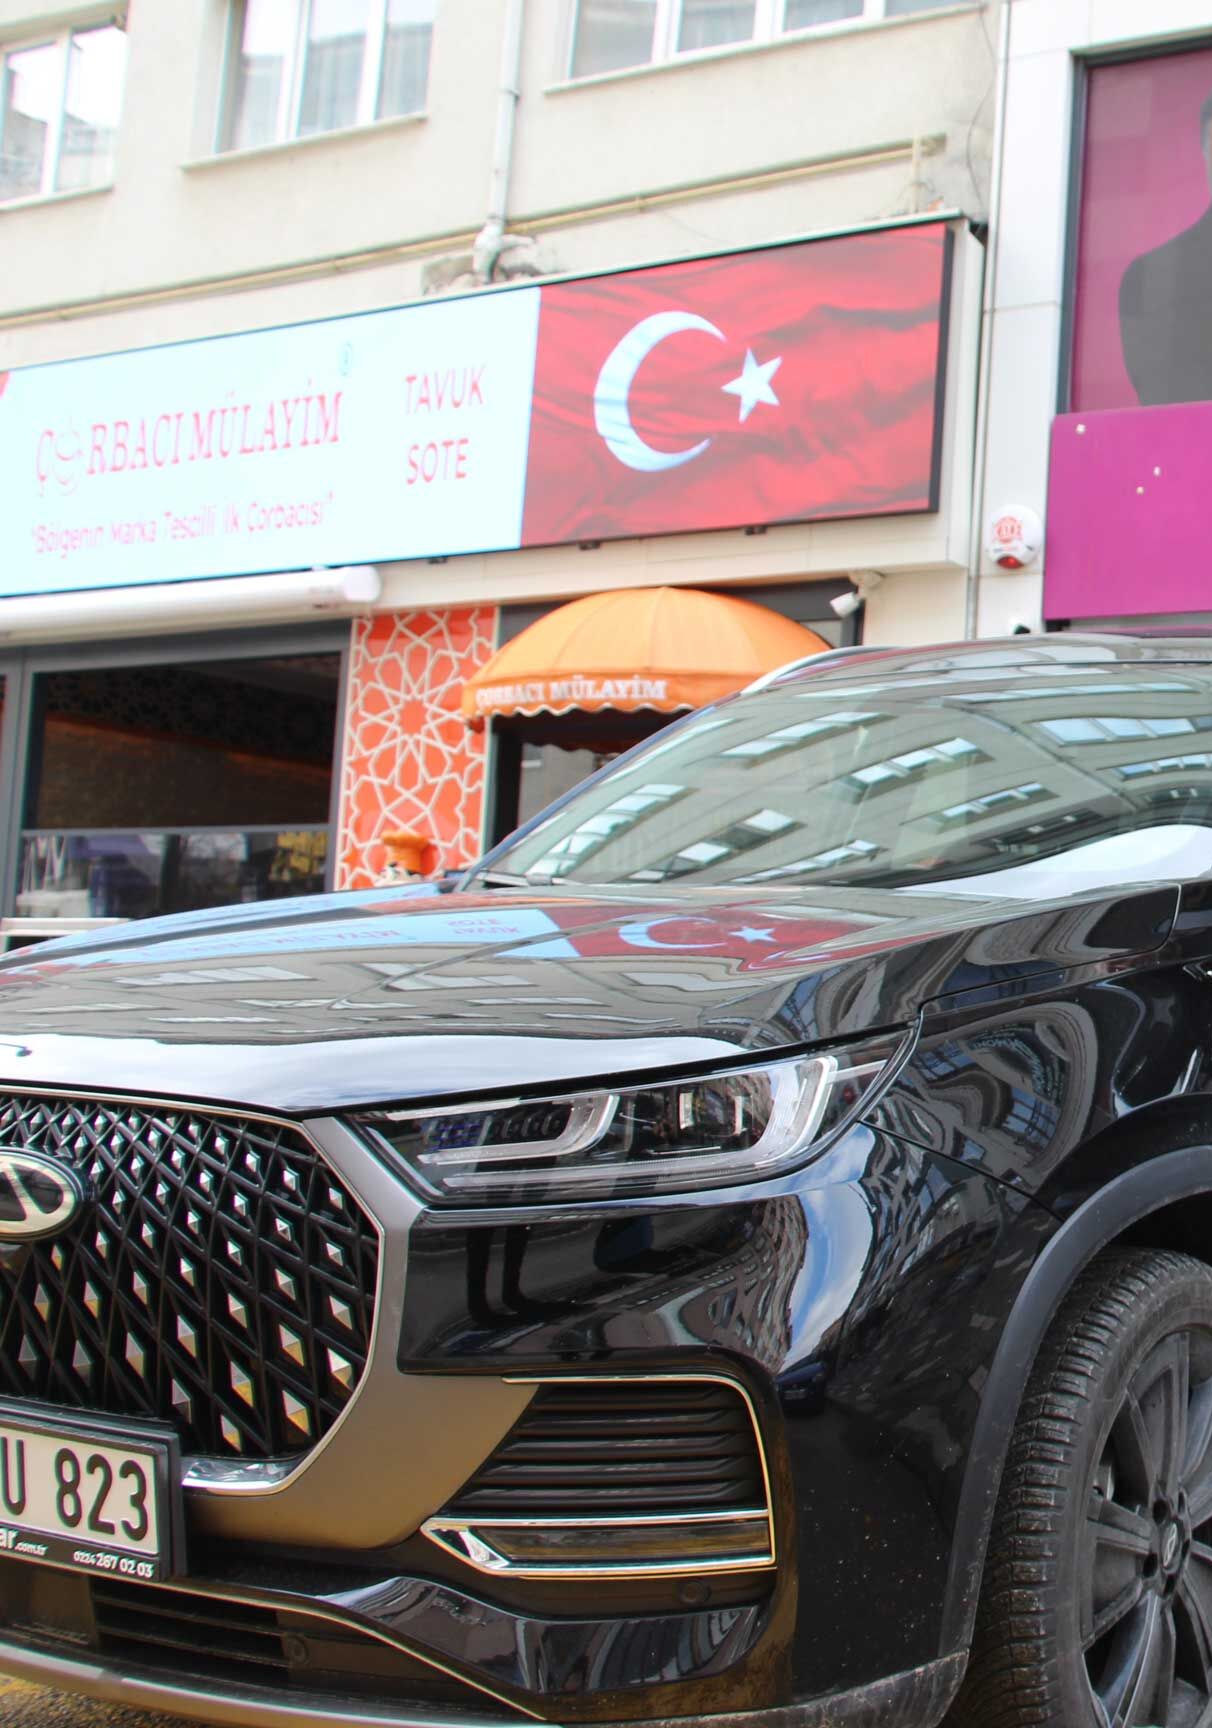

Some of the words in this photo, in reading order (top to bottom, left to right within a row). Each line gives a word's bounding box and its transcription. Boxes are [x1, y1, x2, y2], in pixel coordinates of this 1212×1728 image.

[404, 363, 489, 416] TAVUK
[405, 437, 470, 486] SOTE
[54, 1447, 148, 1541] 823
[119, 1558, 137, 1575] 02
[137, 1562, 155, 1579] 03
